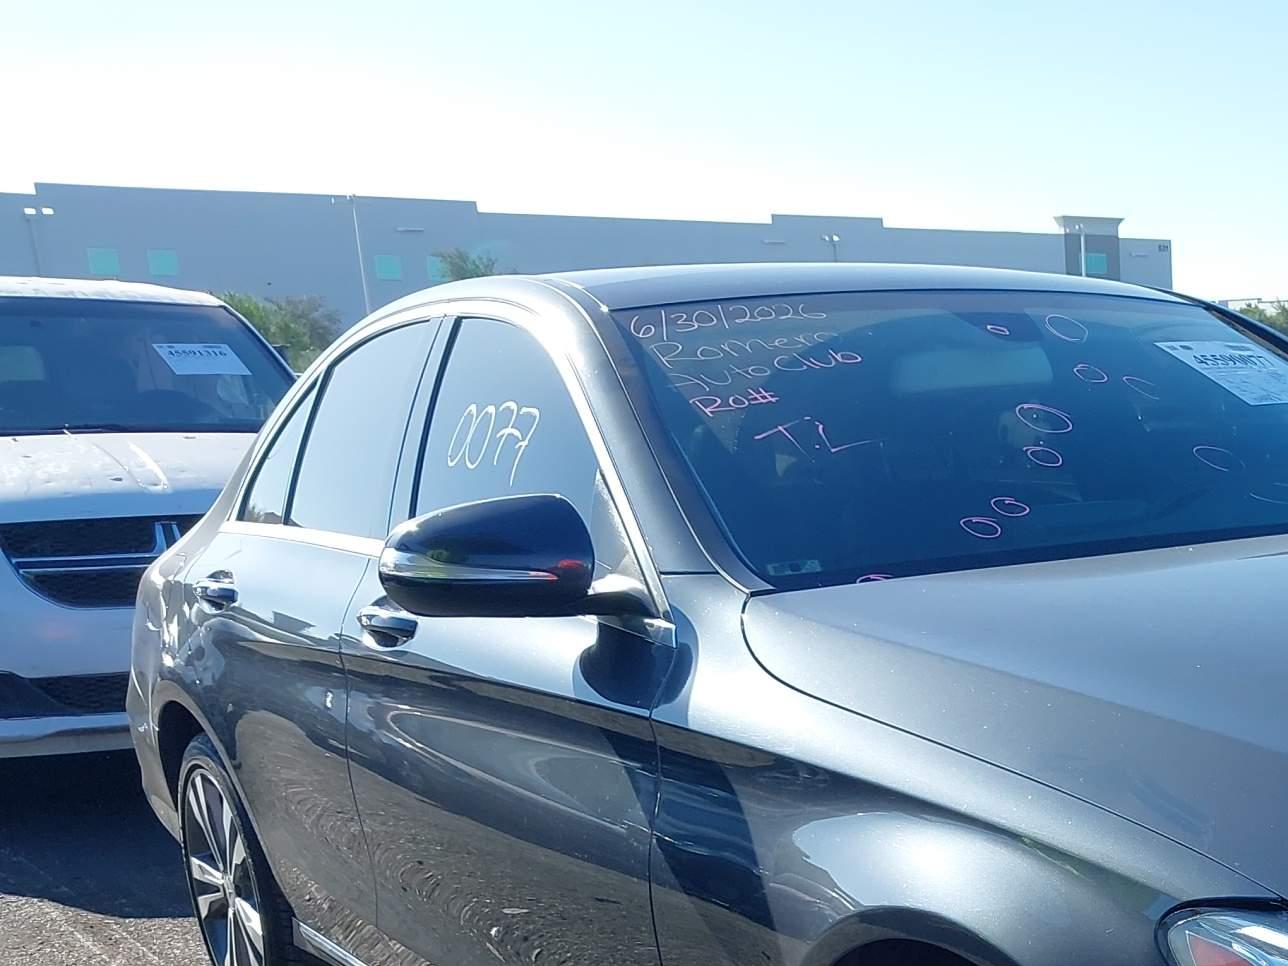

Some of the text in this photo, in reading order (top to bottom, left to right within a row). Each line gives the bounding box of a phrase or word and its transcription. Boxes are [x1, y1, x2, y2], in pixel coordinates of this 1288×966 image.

[631, 304, 826, 341] 6/30/2026
[1192, 354, 1275, 369] 45590077
[447, 400, 541, 488] 0077
